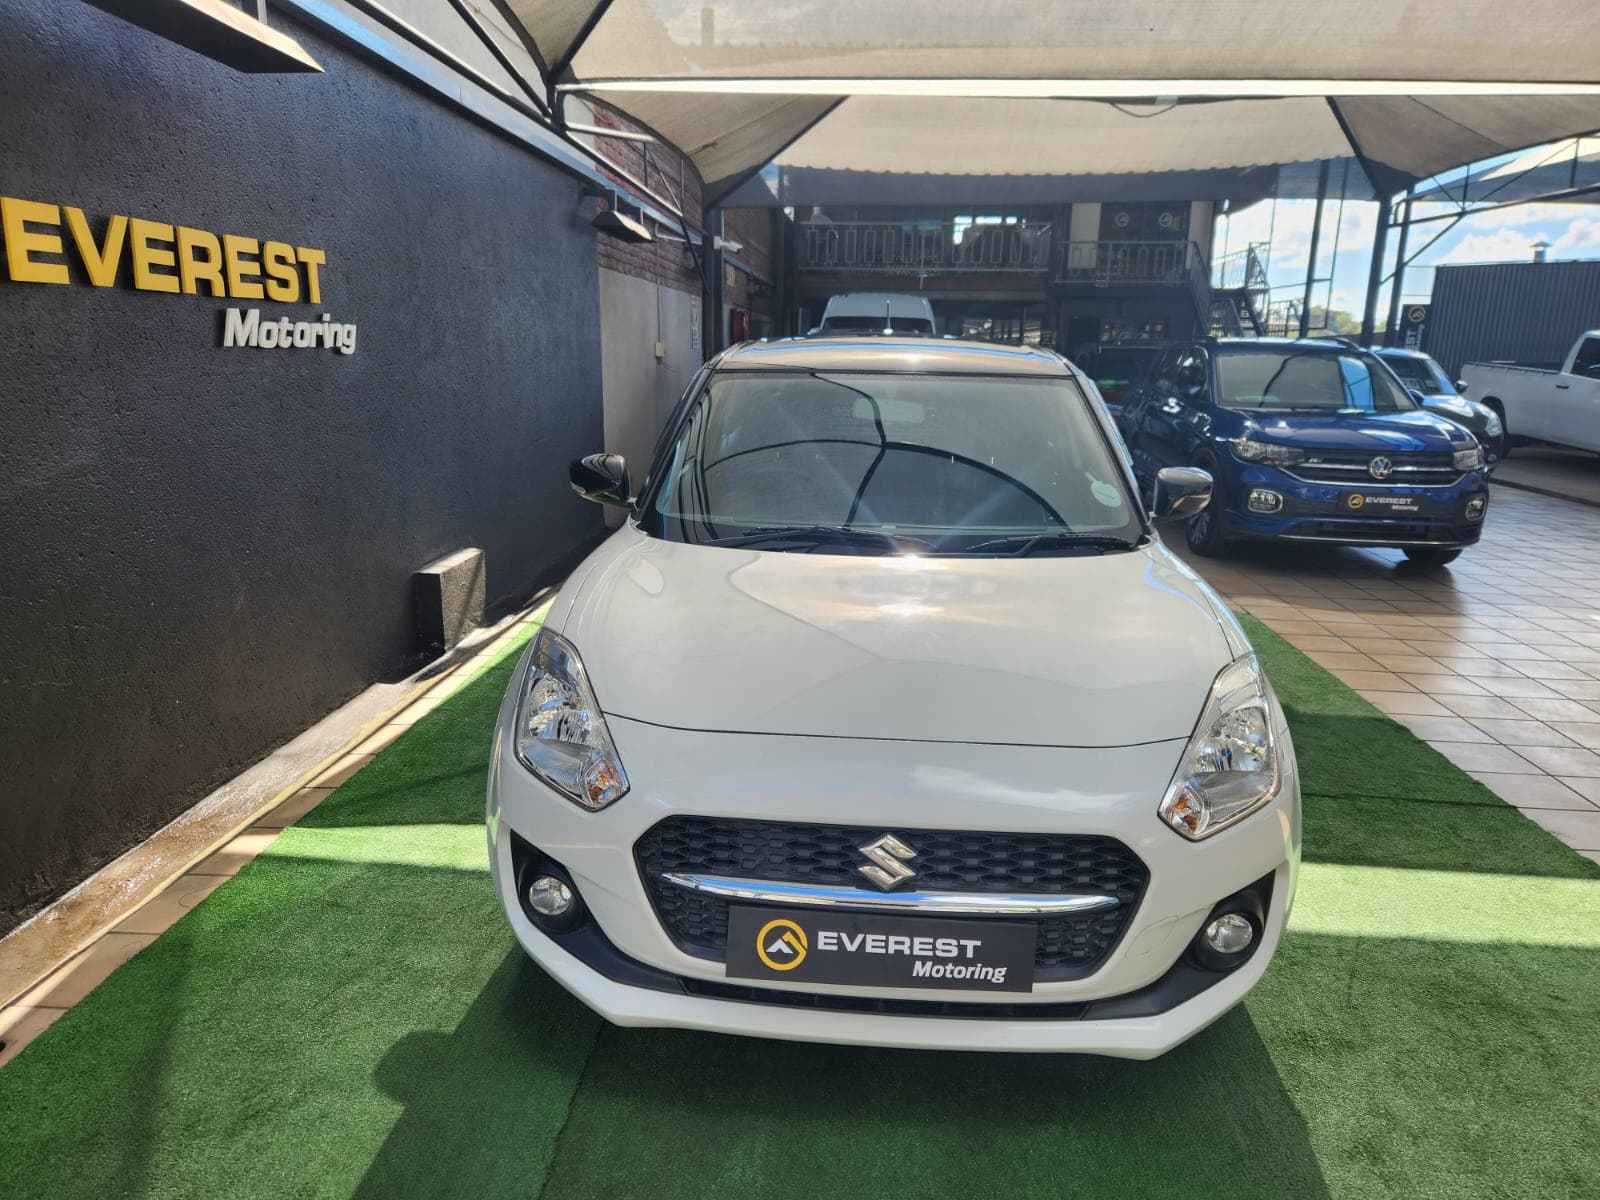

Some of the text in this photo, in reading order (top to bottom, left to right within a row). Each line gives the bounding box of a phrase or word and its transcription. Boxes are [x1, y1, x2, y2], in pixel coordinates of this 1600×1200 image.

[0, 197, 326, 304] EVEREST
[223, 308, 357, 355] Motoring
[1365, 496, 1413, 505] EVEREST
[817, 931, 982, 959] EVEREST
[912, 960, 1008, 984] Motoring
